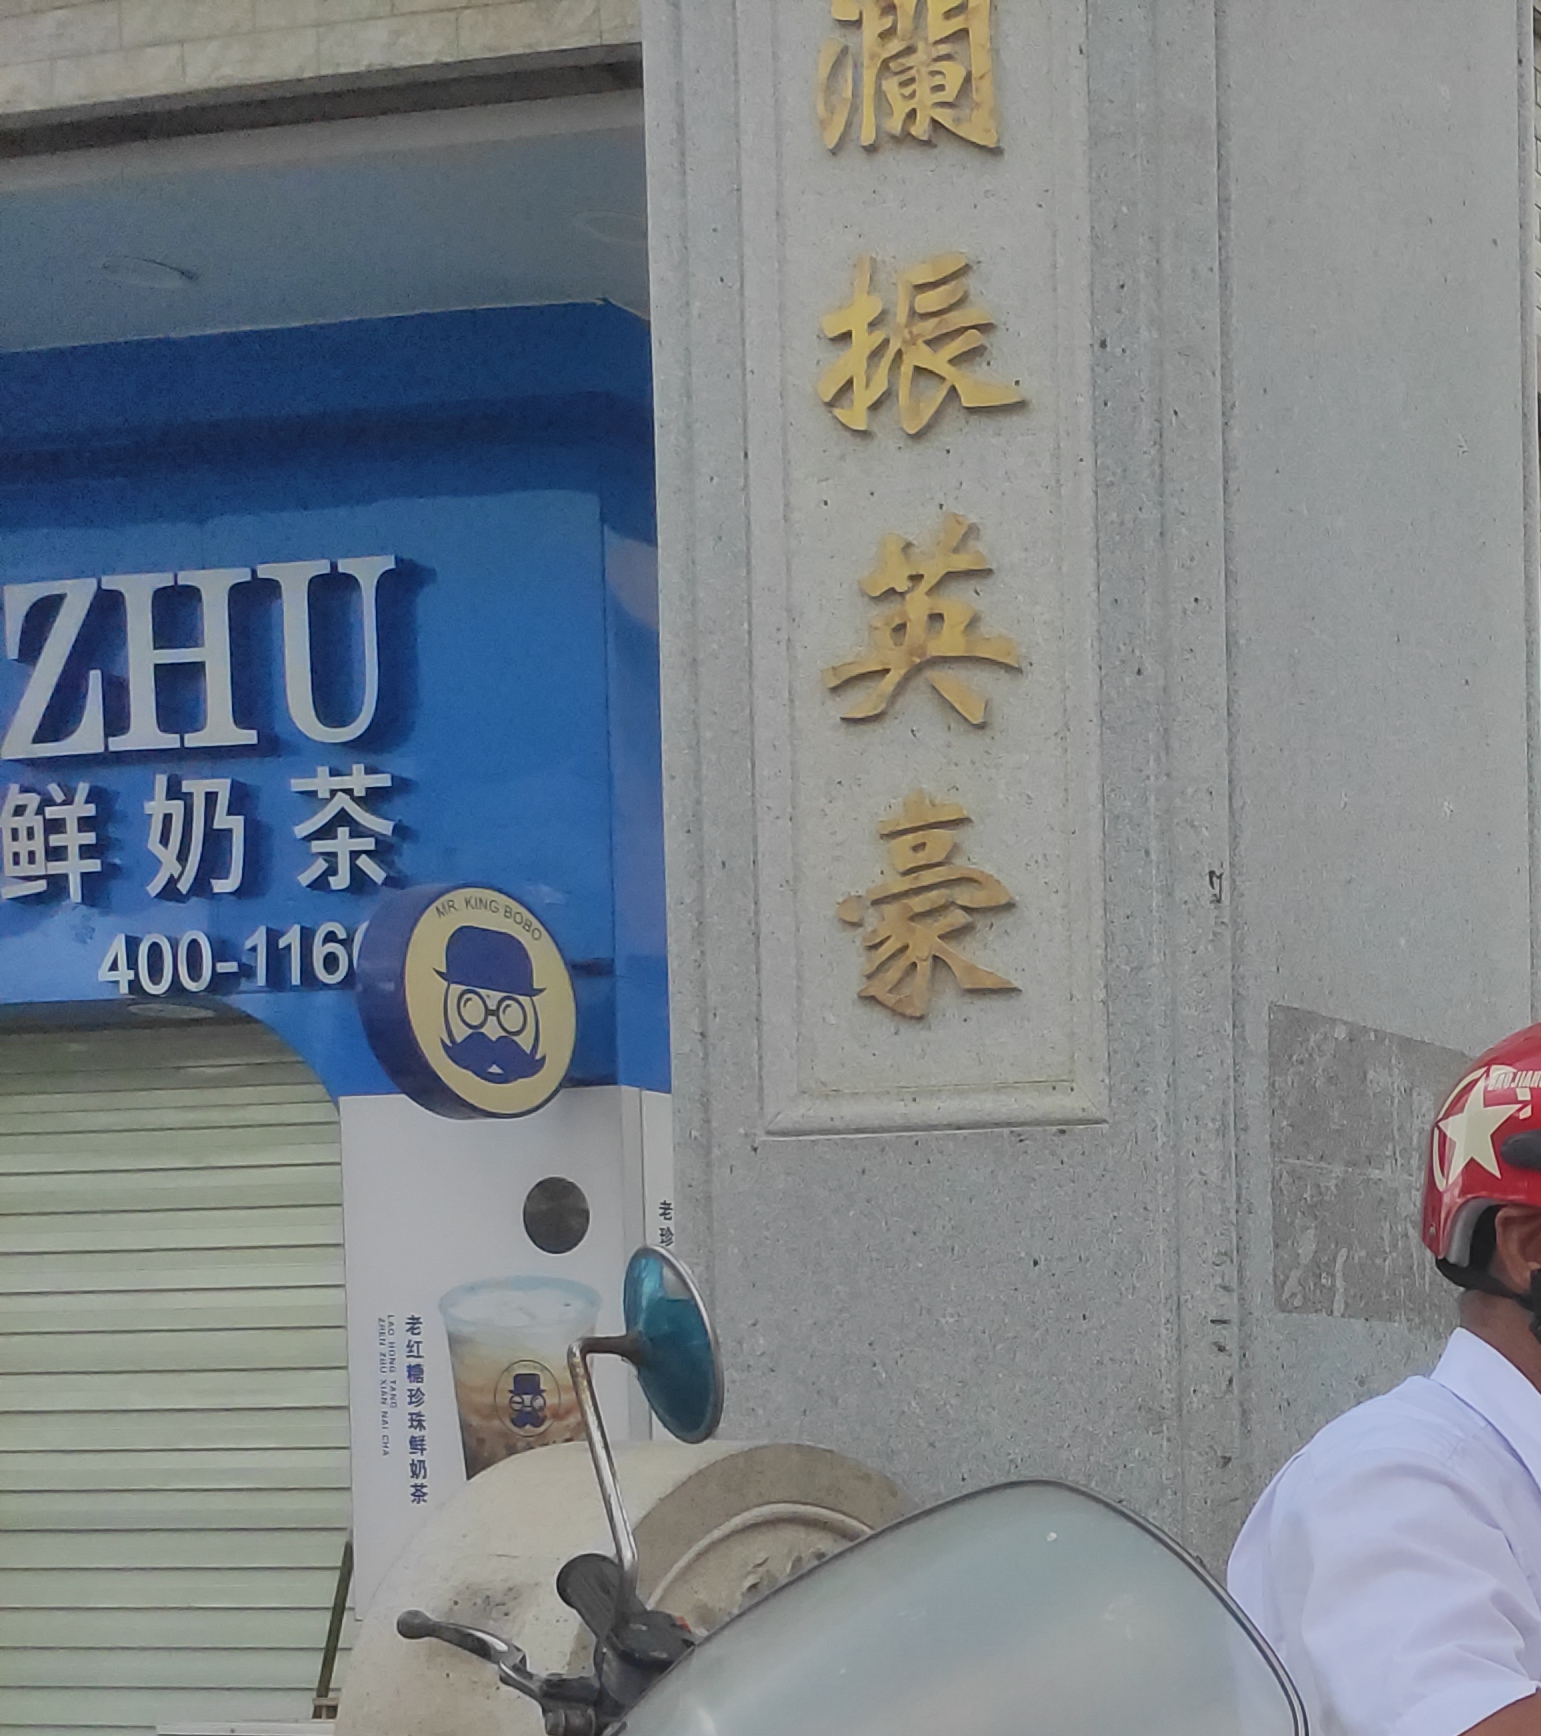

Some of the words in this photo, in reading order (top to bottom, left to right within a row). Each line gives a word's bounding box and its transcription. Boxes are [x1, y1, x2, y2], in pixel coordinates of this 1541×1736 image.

[0, 554, 397, 760] ZHU
[0, 763, 396, 902] 鲜奶茶
[99, 922, 368, 995] 400-116
[464, 896, 500, 913] KING
[503, 904, 543, 941] BOBO
[405, 1314, 429, 1505] 老红糖珍珠鲜奶茶
